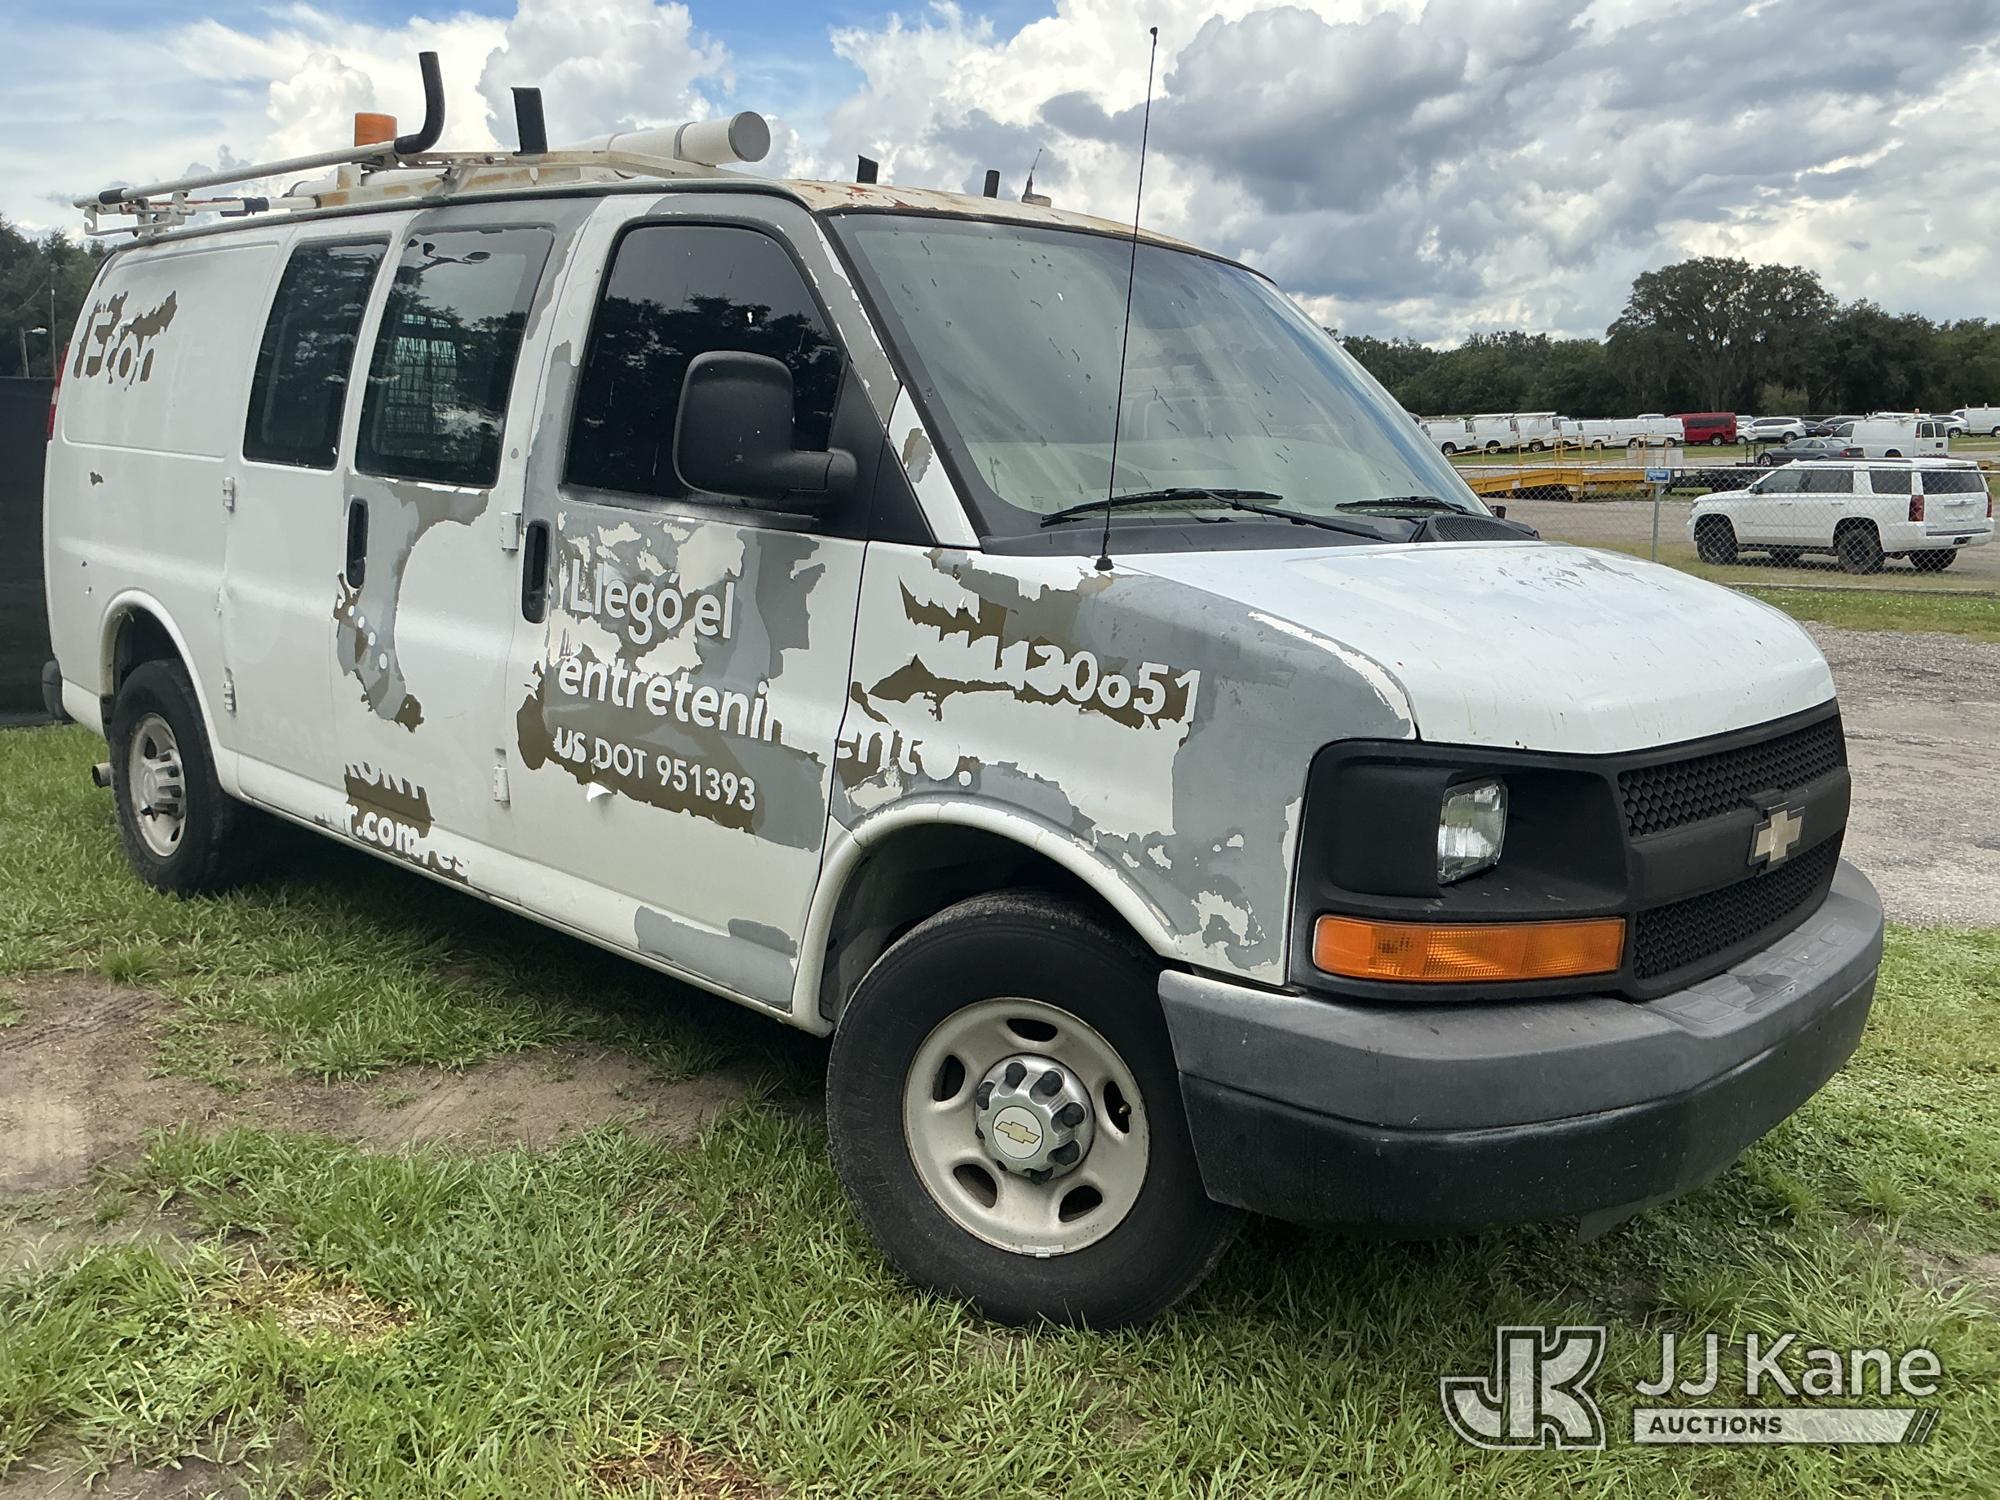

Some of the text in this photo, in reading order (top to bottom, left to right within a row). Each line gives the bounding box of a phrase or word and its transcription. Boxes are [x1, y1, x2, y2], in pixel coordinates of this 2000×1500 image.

[695, 581, 736, 640] el
[553, 727, 757, 812] US DOT 951393
